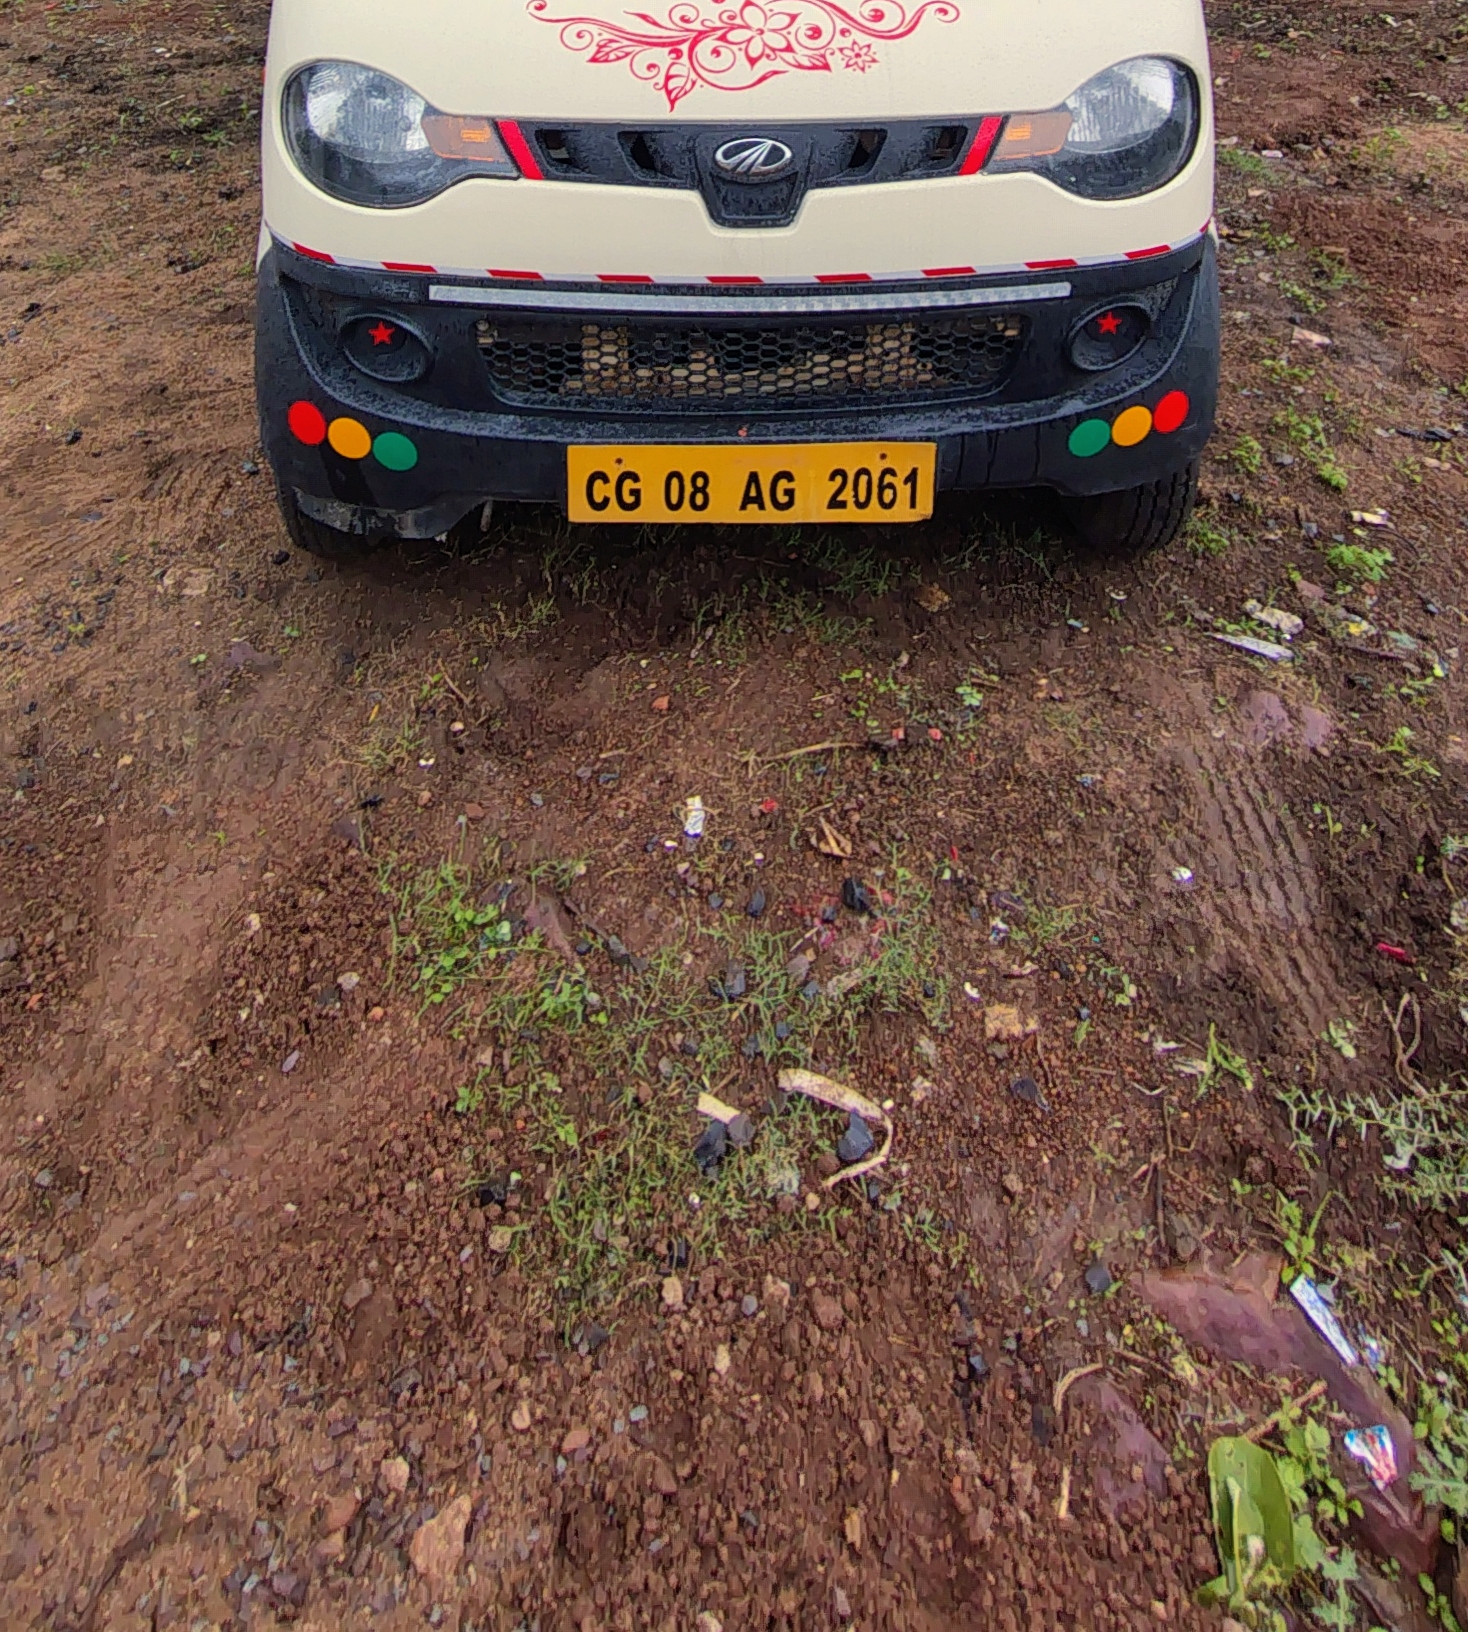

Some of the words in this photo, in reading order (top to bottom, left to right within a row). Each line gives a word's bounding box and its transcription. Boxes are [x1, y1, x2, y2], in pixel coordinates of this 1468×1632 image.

[585, 470, 642, 511] CG
[664, 470, 710, 511] 08
[739, 470, 796, 511] AG
[827, 467, 920, 510] 2061
